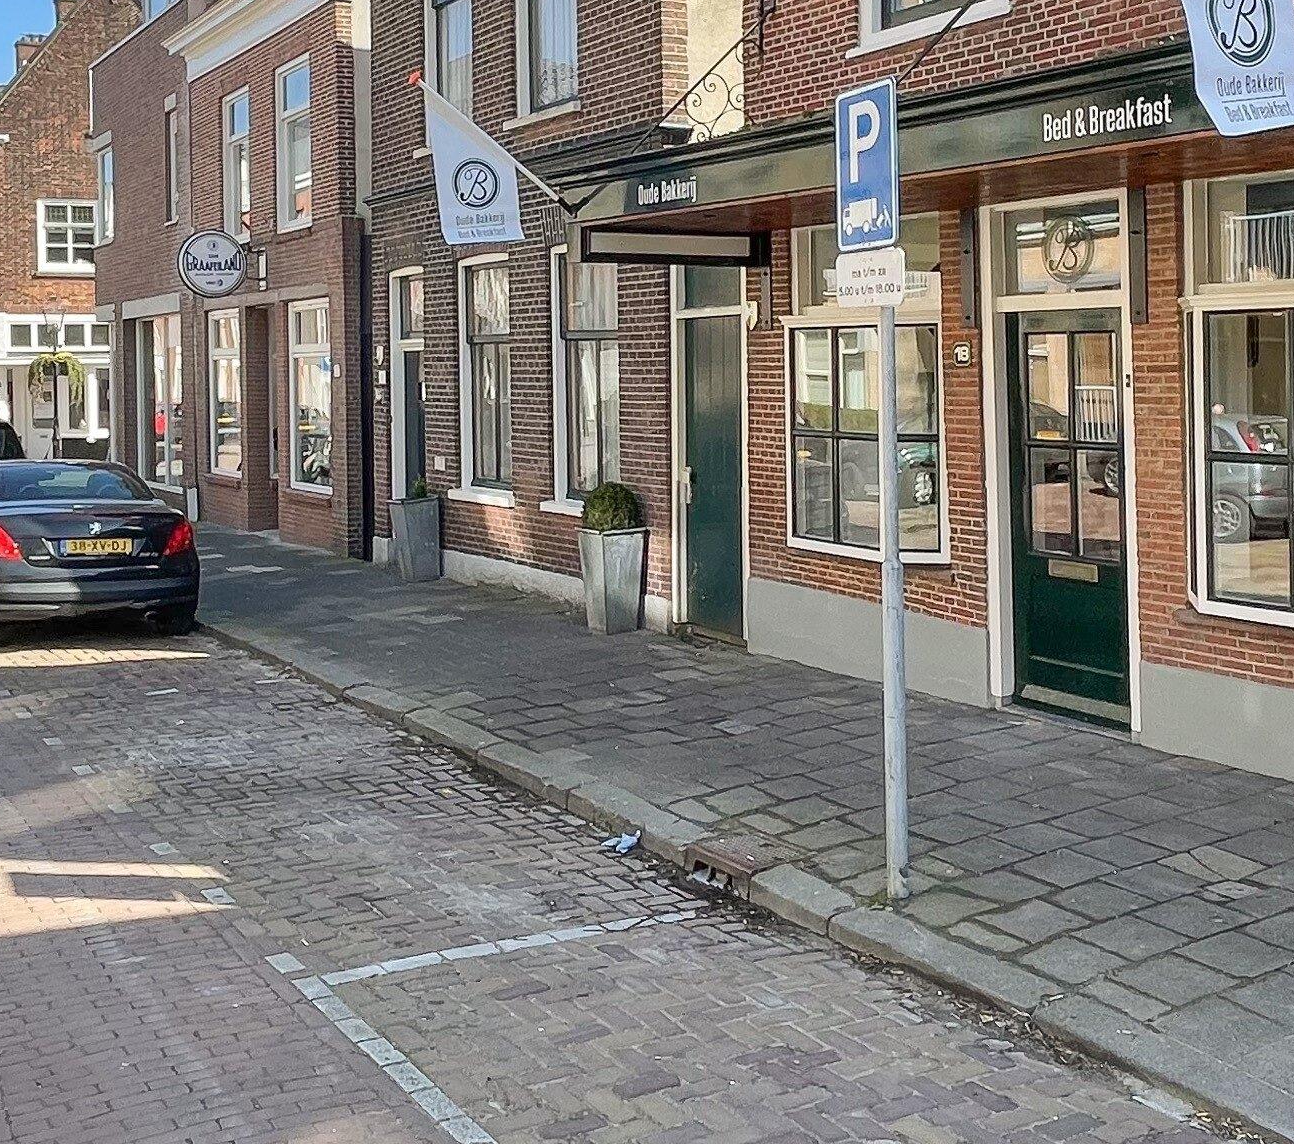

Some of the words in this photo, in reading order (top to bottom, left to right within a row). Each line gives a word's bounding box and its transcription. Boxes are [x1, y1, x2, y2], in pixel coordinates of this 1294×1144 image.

[1216, 75, 1243, 97] Oude
[1245, 71, 1286, 97] Bakkerij
[1042, 112, 1071, 143] Bed
[1074, 110, 1087, 136] &
[1089, 93, 1174, 134] Breakfast
[1224, 105, 1242, 123] Bed
[1251, 100, 1294, 121] Breakfast
[849, 99, 881, 184] P
[460, 168, 487, 202] B
[637, 183, 660, 205] Oude
[661, 175, 697, 203] Bakkerij
[953, 344, 970, 362] 18
